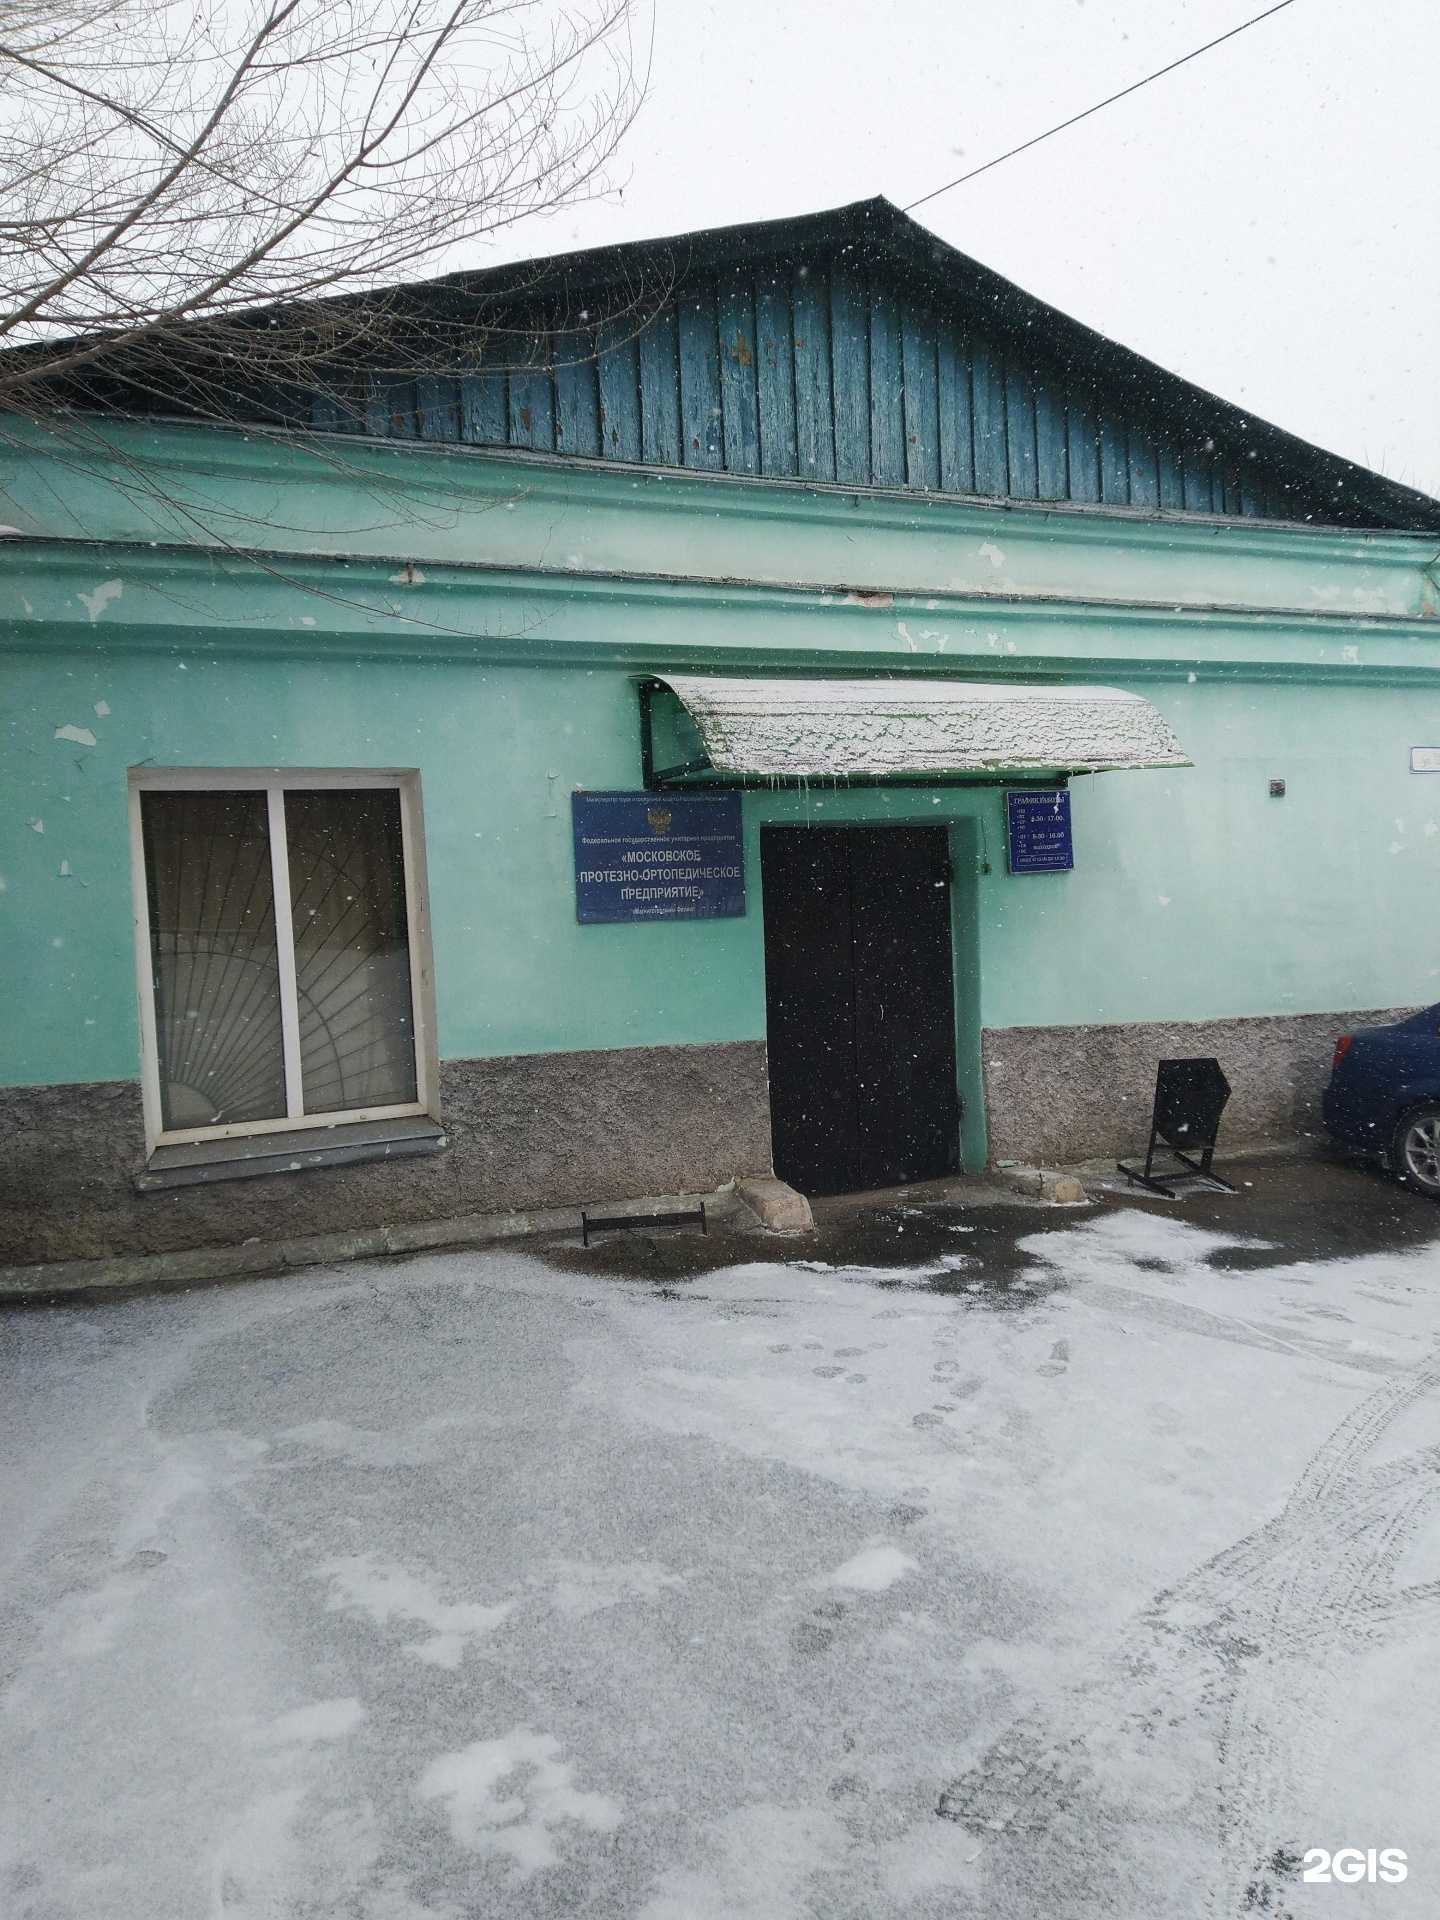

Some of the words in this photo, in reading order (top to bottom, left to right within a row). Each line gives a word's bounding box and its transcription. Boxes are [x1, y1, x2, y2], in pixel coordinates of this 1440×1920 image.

[622, 850, 702, 863] «МОСКОВСКОЕ
[580, 866, 741, 883] ПРОТЕЗНО-ОРТОПЕДИЧЕСКОЕ
[621, 886, 704, 901] ПРЕДПРИЯТИЕ»
